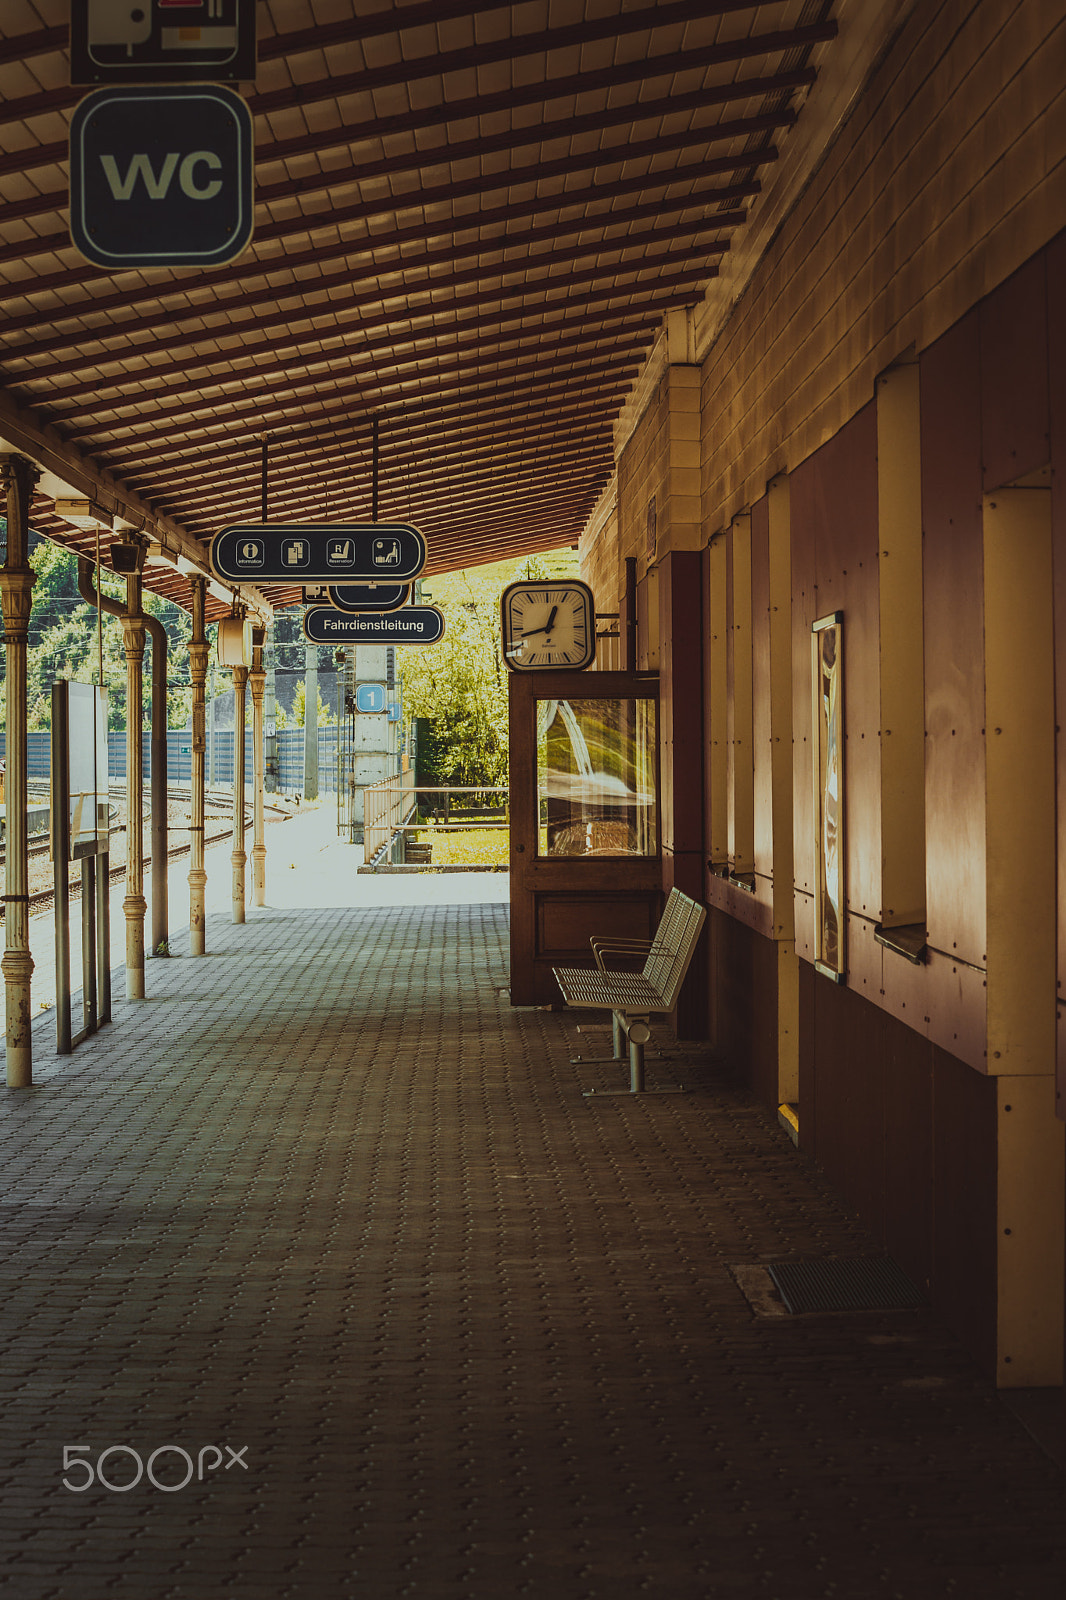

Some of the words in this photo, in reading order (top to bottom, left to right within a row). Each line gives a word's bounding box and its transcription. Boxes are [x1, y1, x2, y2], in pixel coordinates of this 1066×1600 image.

[100, 151, 223, 200] WC
[335, 544, 342, 553] R
[323, 619, 424, 632] Fahrdienstleitung
[367, 691, 375, 706] 1
[390, 706, 395, 717] 1
